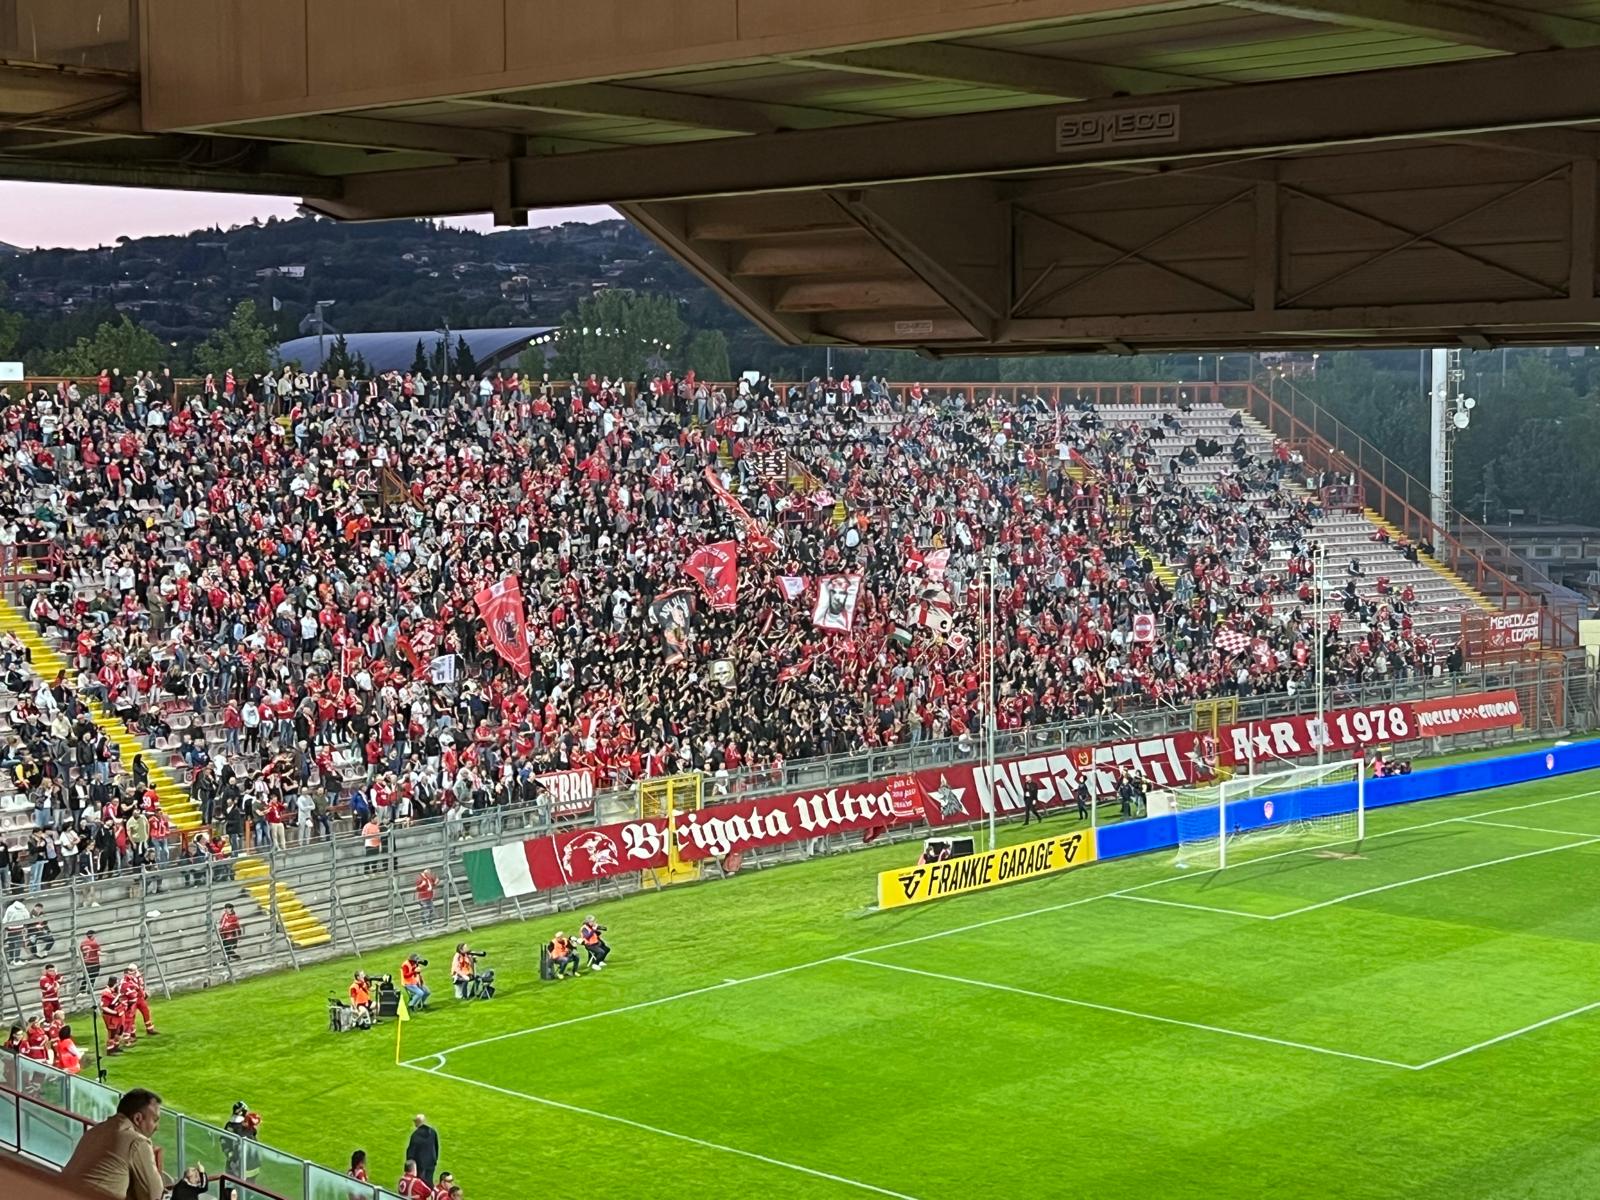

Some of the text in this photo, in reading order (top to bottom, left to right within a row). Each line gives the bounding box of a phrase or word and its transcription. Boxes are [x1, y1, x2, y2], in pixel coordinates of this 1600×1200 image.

[1060, 111, 1175, 141] SOMECO
[1336, 706, 1408, 745] 1978
[1417, 708, 1460, 727] NUCLEO
[621, 806, 793, 861] Brigata
[927, 854, 996, 896] FRANKIE
[997, 840, 1056, 881] GARAGE
